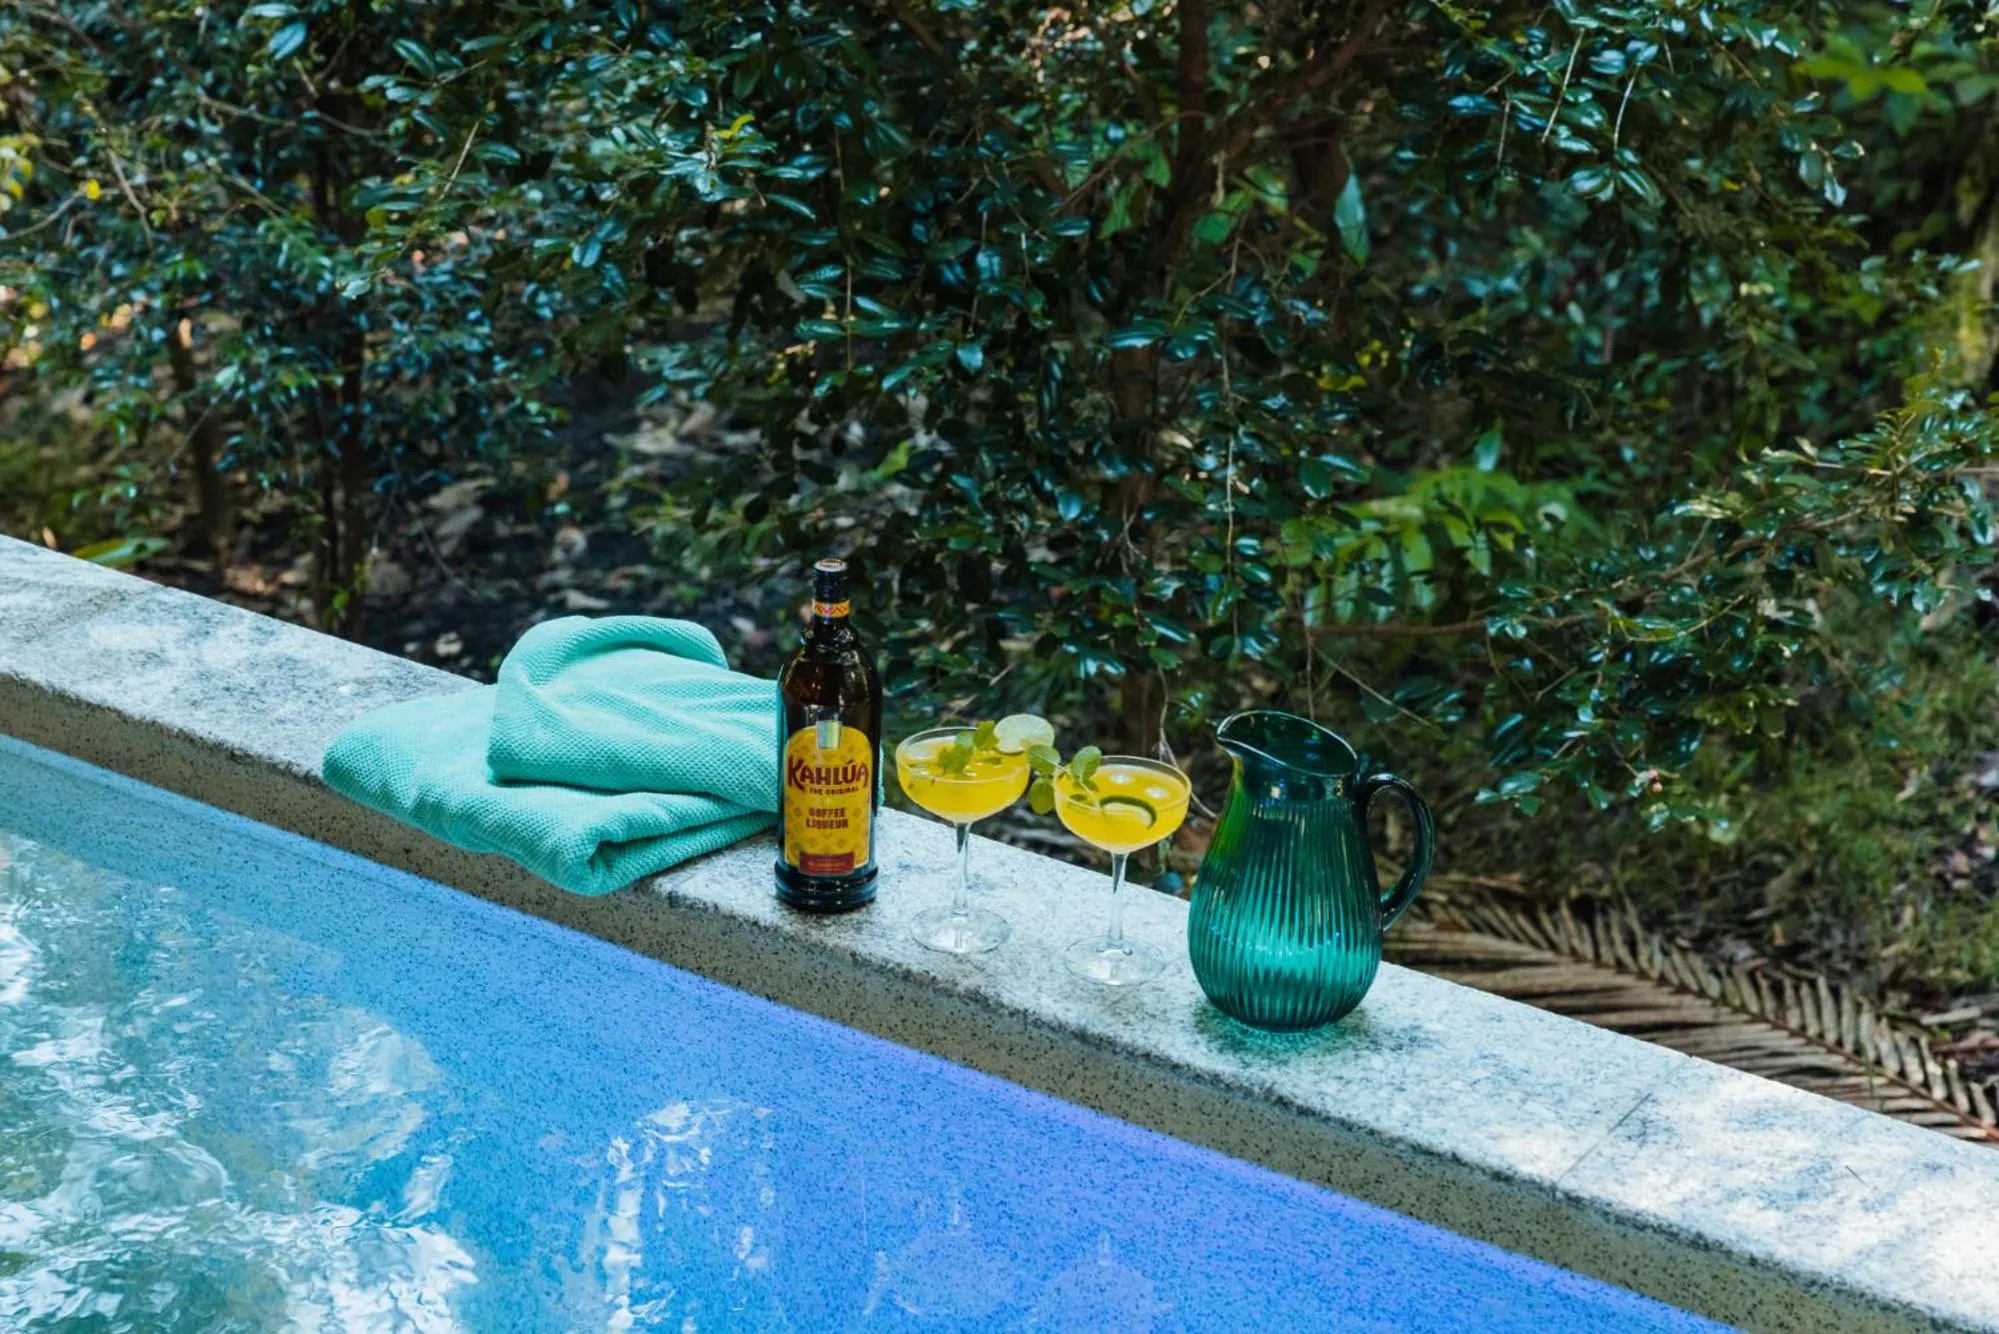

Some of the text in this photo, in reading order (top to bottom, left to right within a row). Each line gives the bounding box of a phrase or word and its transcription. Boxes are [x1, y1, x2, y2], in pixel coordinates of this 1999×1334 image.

[788, 755, 869, 791] KAHLÚA
[809, 808, 845, 818] COFFEE
[806, 818, 848, 829] LIQUEUR
